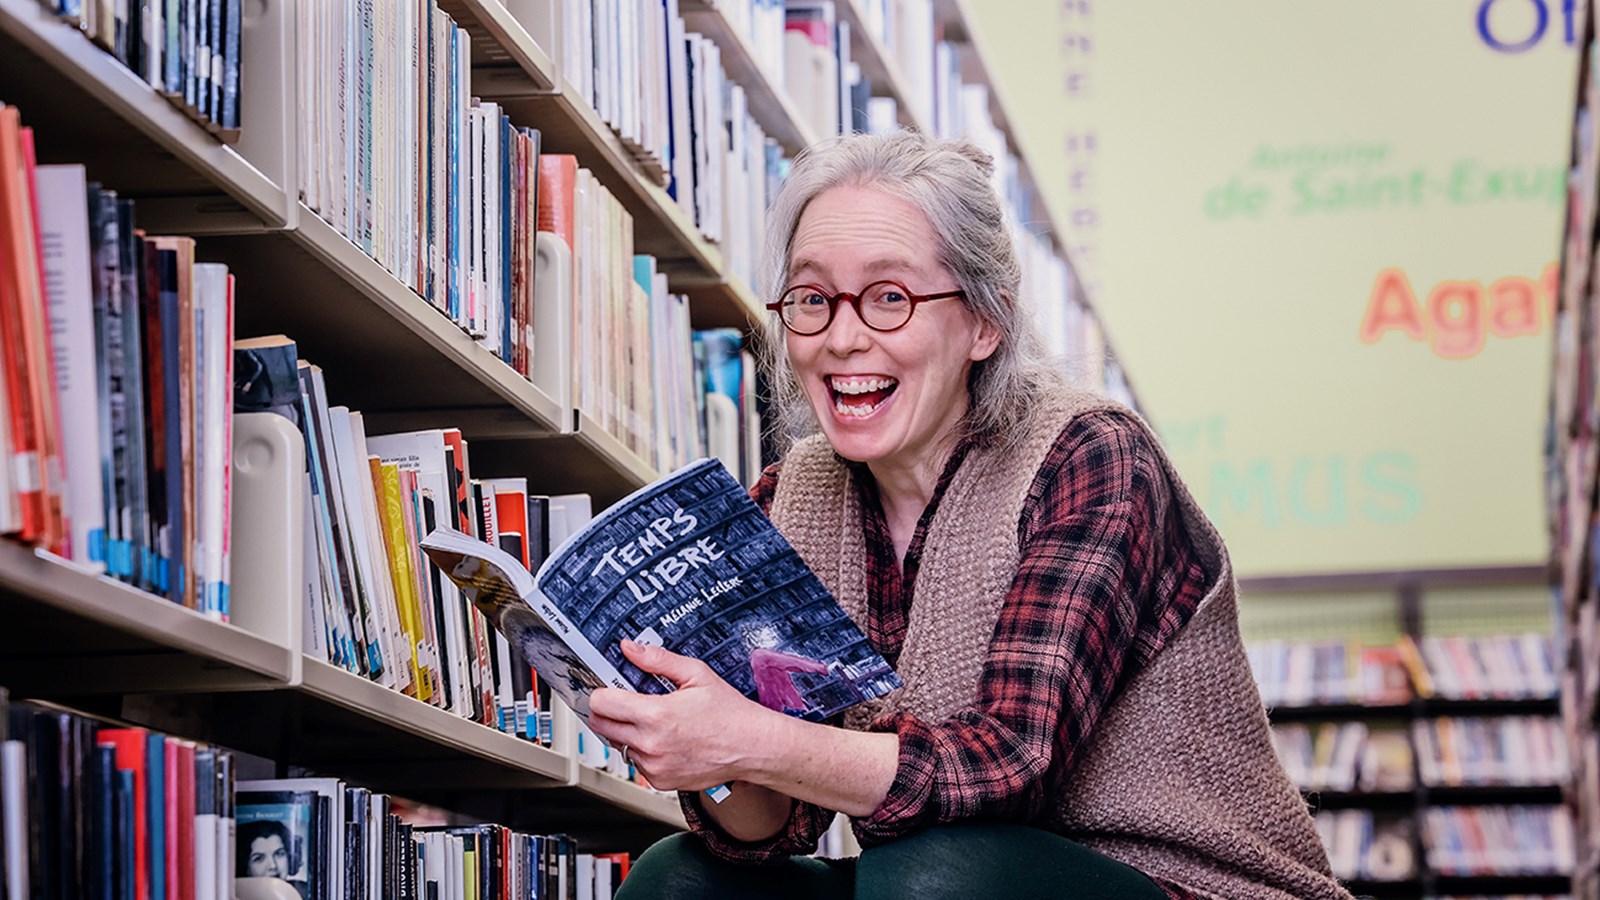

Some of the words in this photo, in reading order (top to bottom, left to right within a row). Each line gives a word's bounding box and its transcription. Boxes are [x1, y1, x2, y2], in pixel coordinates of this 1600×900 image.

[1203, 173, 1270, 222] de
[482, 496, 495, 547] ROUILLET
[592, 507, 698, 577] TEMPS
